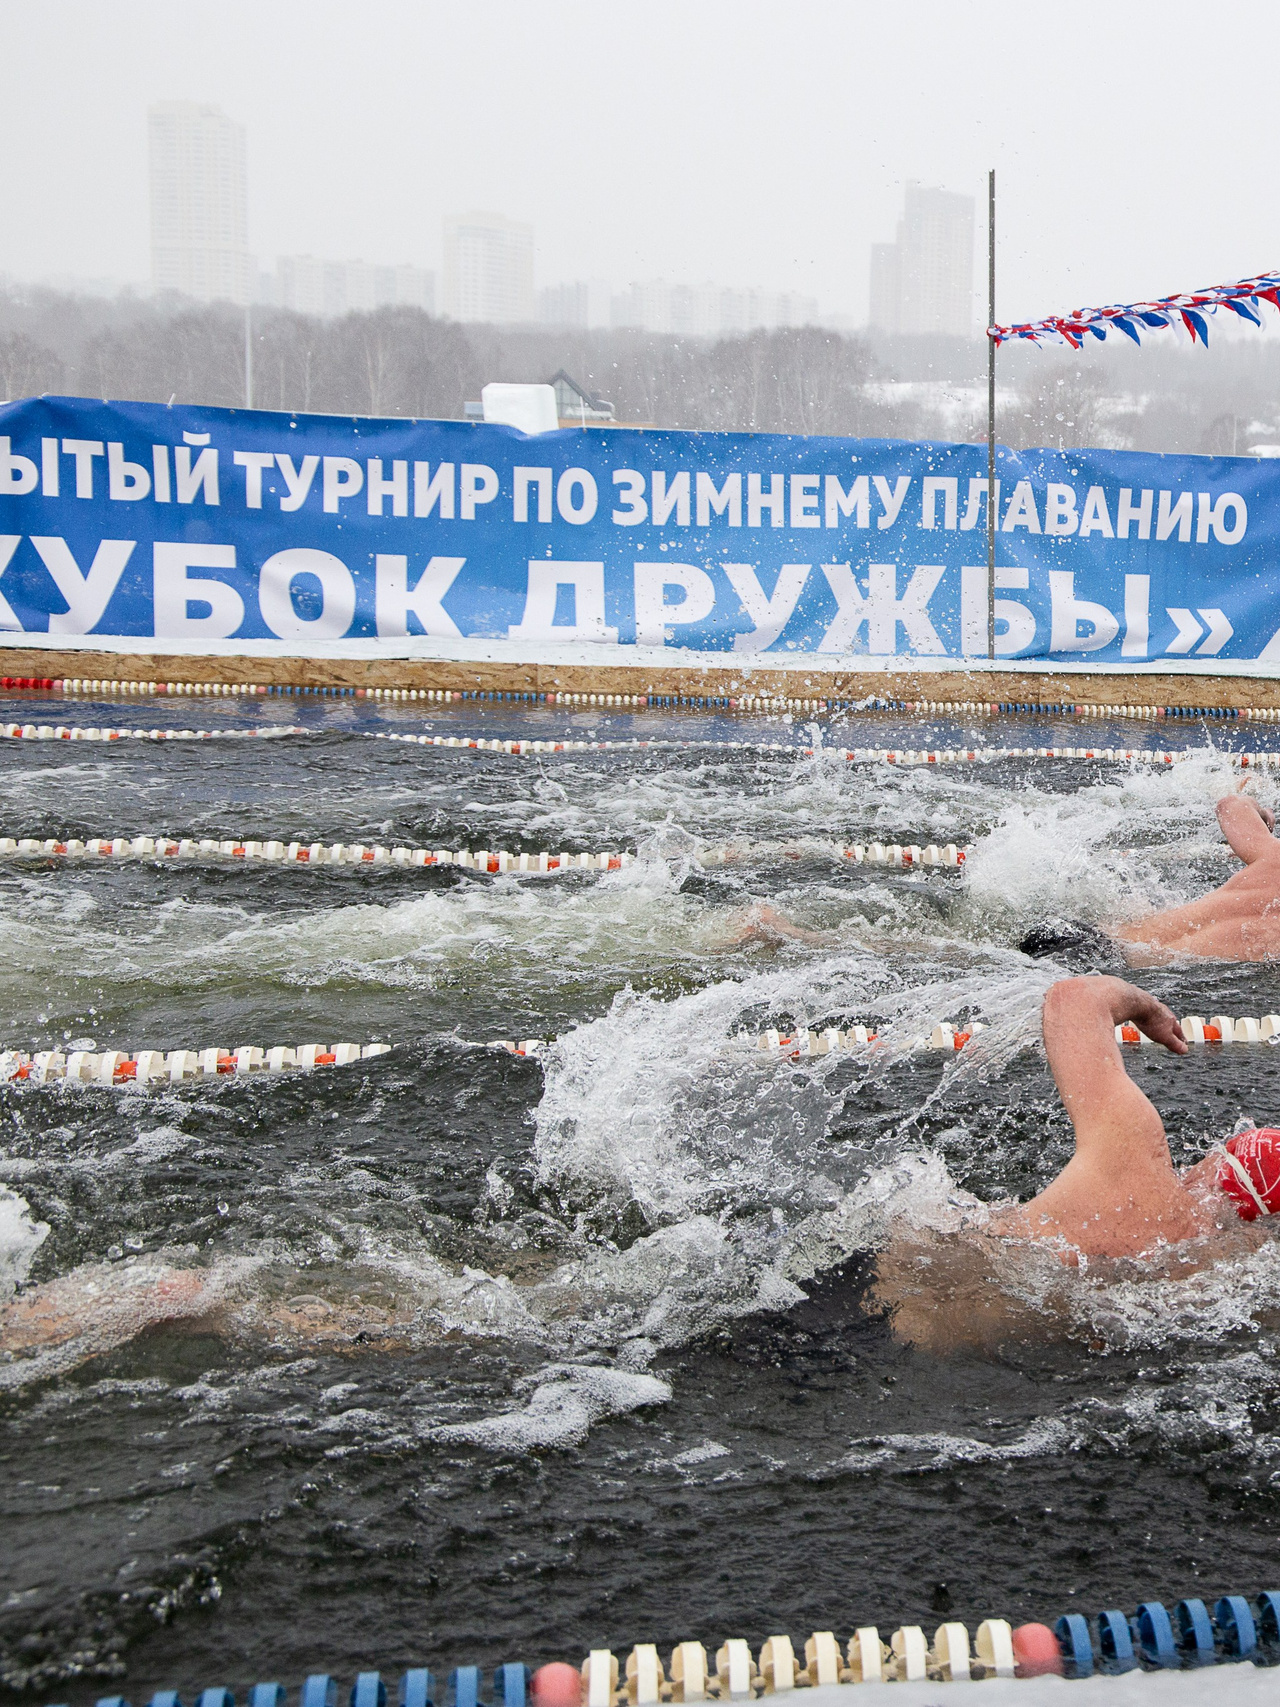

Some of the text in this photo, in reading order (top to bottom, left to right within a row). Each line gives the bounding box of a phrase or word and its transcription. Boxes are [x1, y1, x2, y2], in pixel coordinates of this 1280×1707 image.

[0, 431, 1248, 545] ЫТЫЙ ТУРНИР ПО ЗИМНЕМУ ПЛАВАНИЮ
[508, 560, 1234, 657] ДРУЖБЫ»
